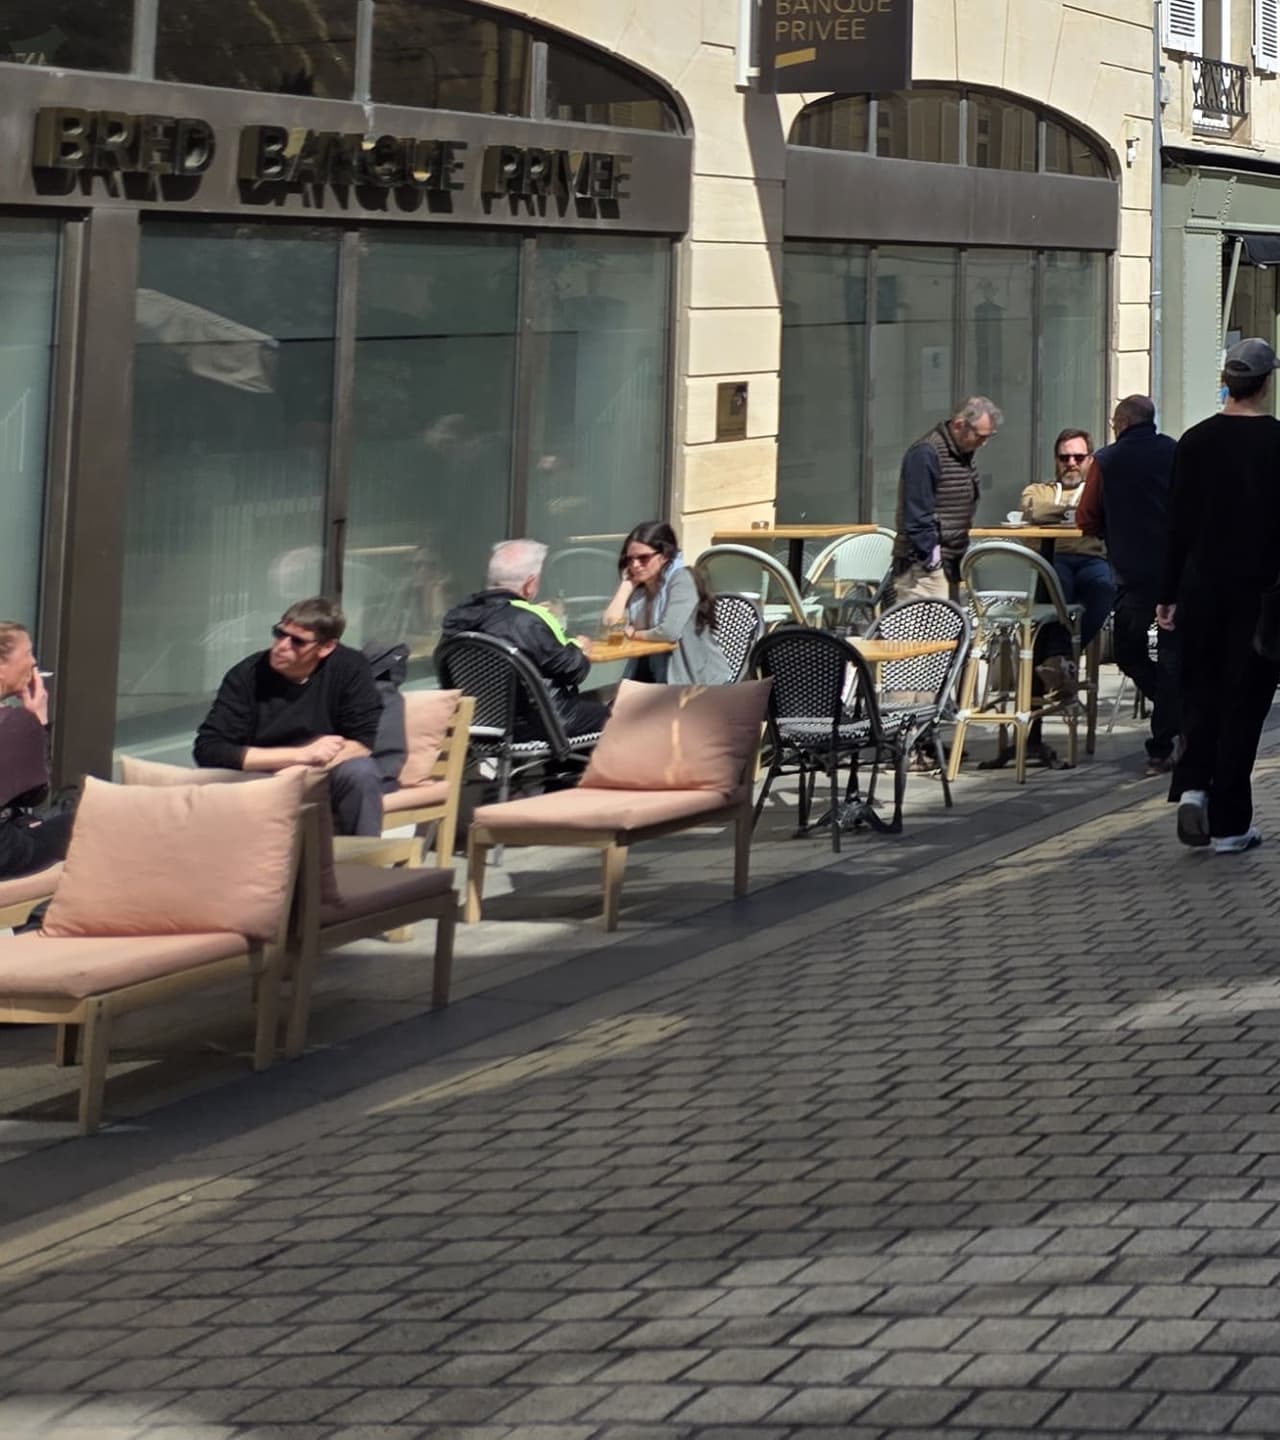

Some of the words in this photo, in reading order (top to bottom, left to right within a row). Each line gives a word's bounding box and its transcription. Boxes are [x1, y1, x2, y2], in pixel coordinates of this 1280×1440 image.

[775, 14, 867, 41] PRIVÉE
[33, 106, 215, 176] BRED
[237, 124, 468, 192] BANQUE
